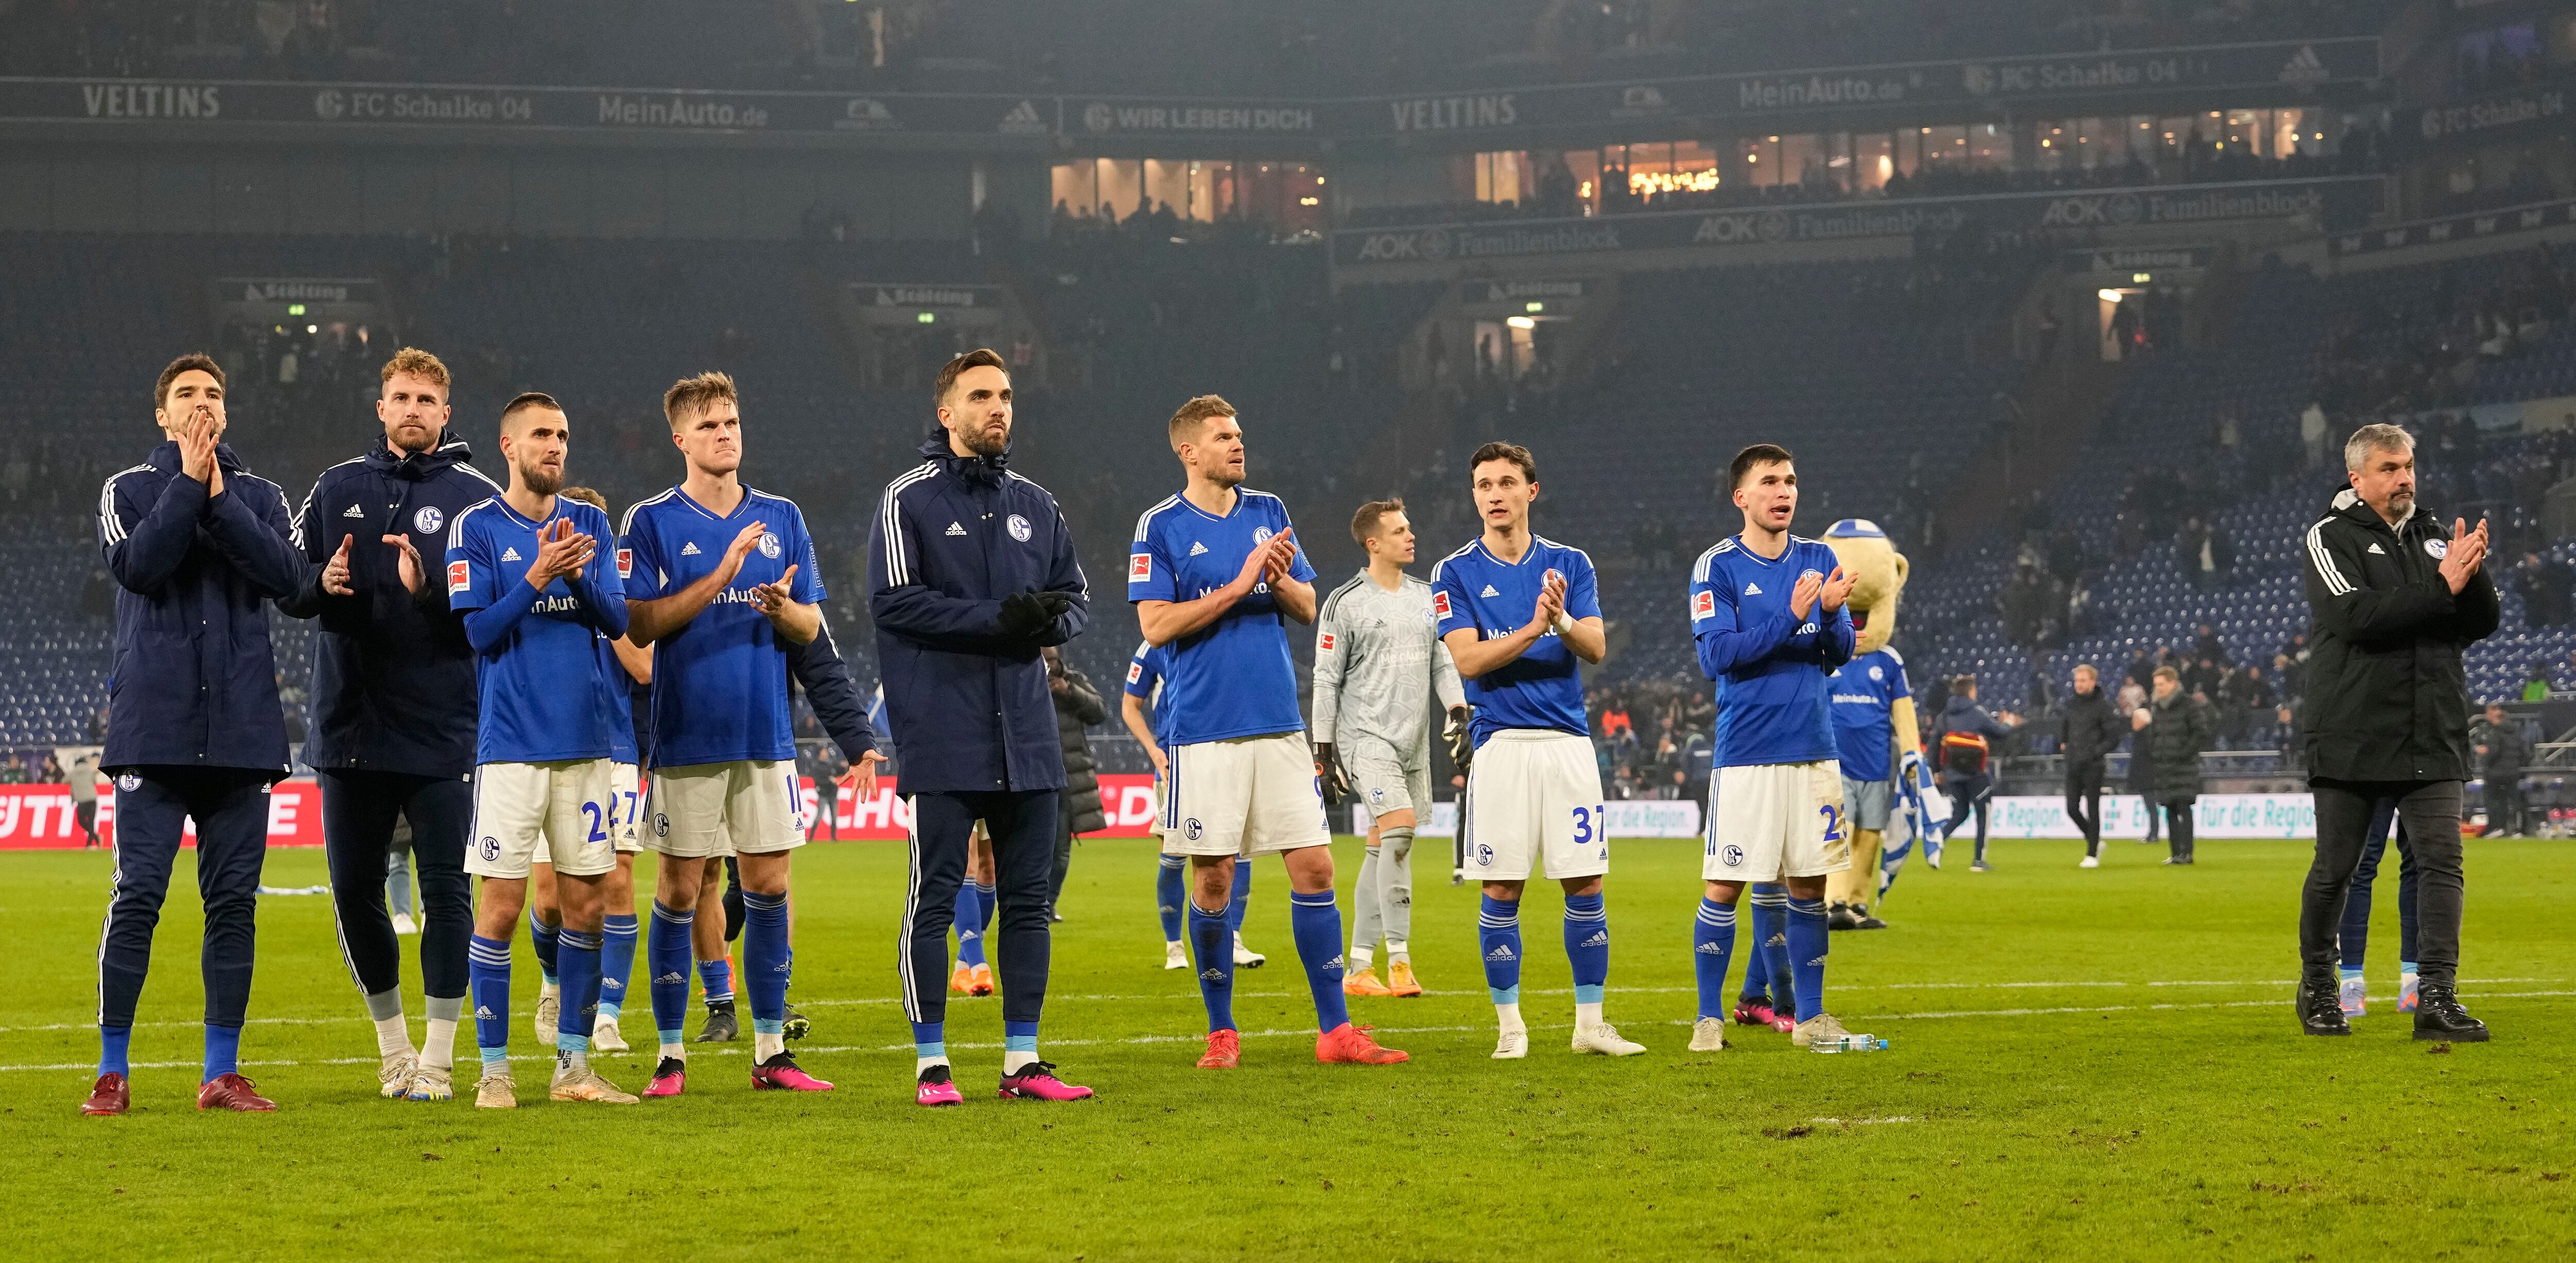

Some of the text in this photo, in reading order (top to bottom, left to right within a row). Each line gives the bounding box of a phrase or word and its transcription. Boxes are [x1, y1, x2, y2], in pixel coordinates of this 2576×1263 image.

[2040, 61, 2139, 89] Schalke
[2147, 58, 2178, 82] 04
[83, 86, 219, 117] VELTINS
[351, 93, 532, 120] FC Schalke 04
[599, 95, 768, 126] MeinAuto.de
[1392, 95, 1517, 130] VELTINS
[1117, 108, 1313, 129] WIR LEBEN DICH
[2042, 197, 2106, 225] AOK
[1694, 216, 1756, 242] AOK
[1358, 234, 1419, 259] AOK
[1190, 548, 1209, 556] adidas
[1572, 805, 1604, 844] 37
[2265, 798, 2315, 839] Regio
[1696, 947, 1724, 955] adidas
